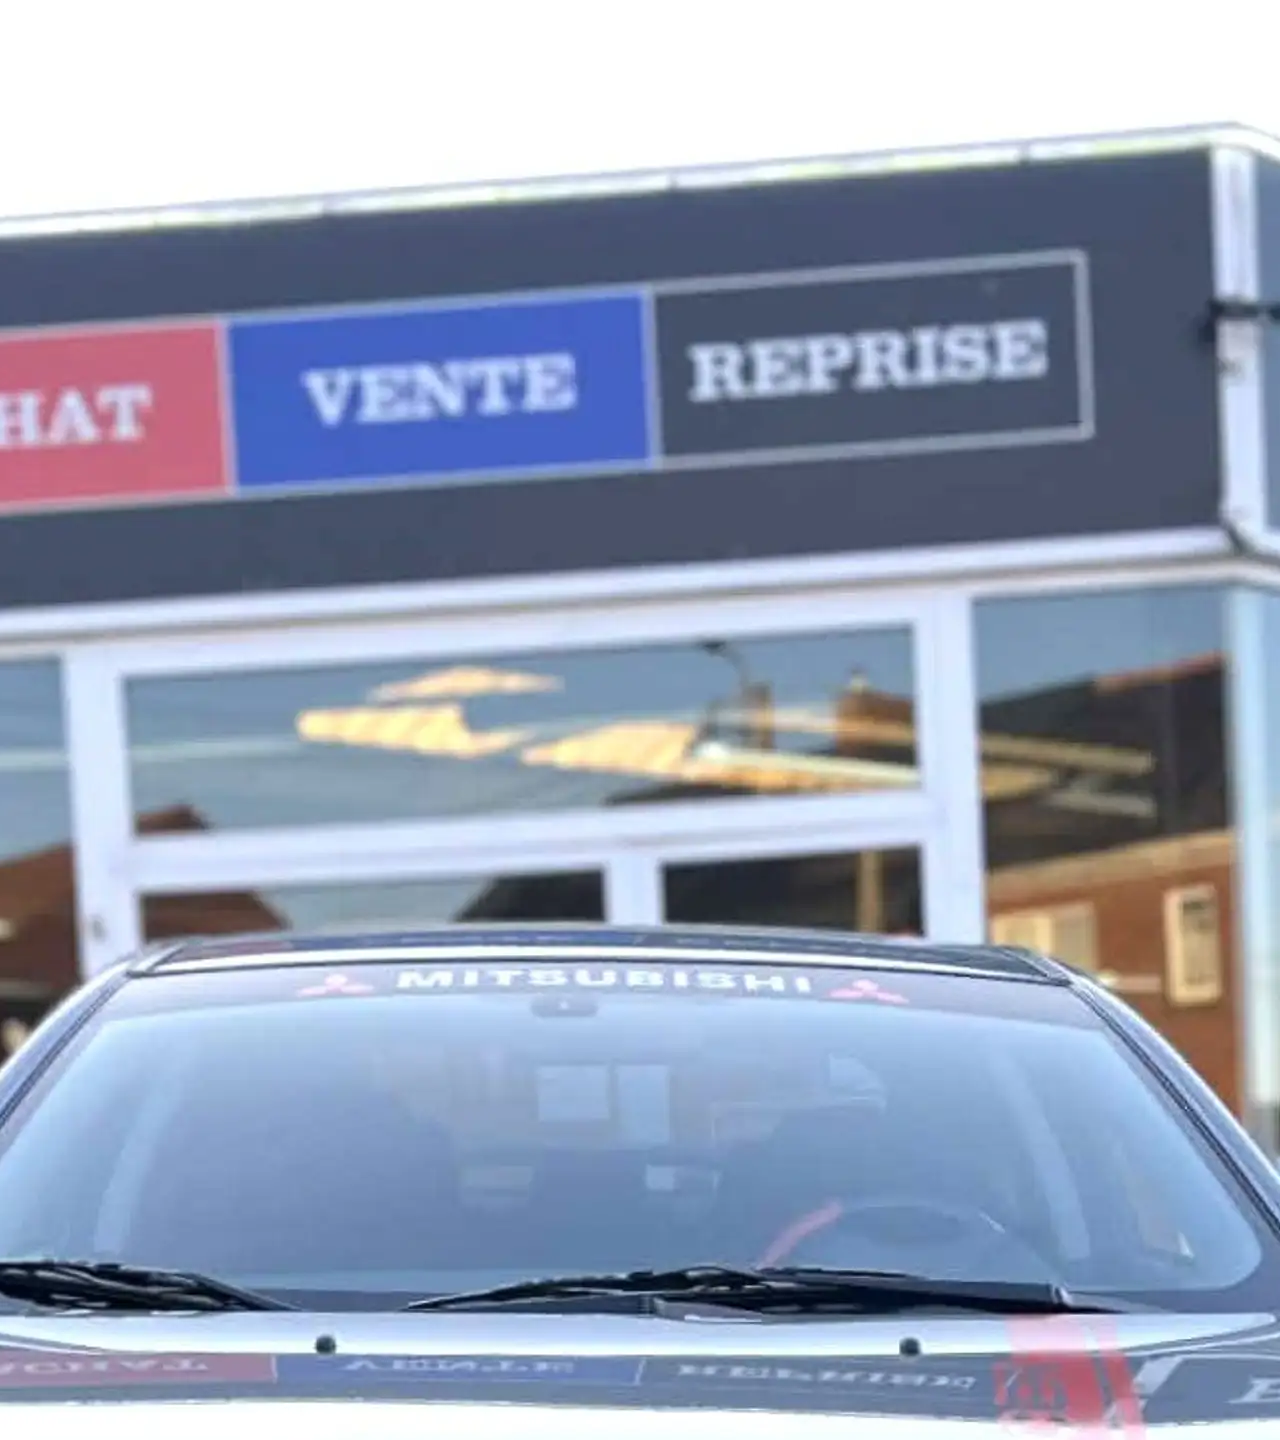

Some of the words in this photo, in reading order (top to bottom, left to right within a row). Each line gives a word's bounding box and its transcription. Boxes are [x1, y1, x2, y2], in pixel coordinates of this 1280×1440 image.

[301, 352, 578, 427] VENTE
[687, 317, 1048, 403] REPRISE
[396, 968, 812, 993] MITSUBISHI
